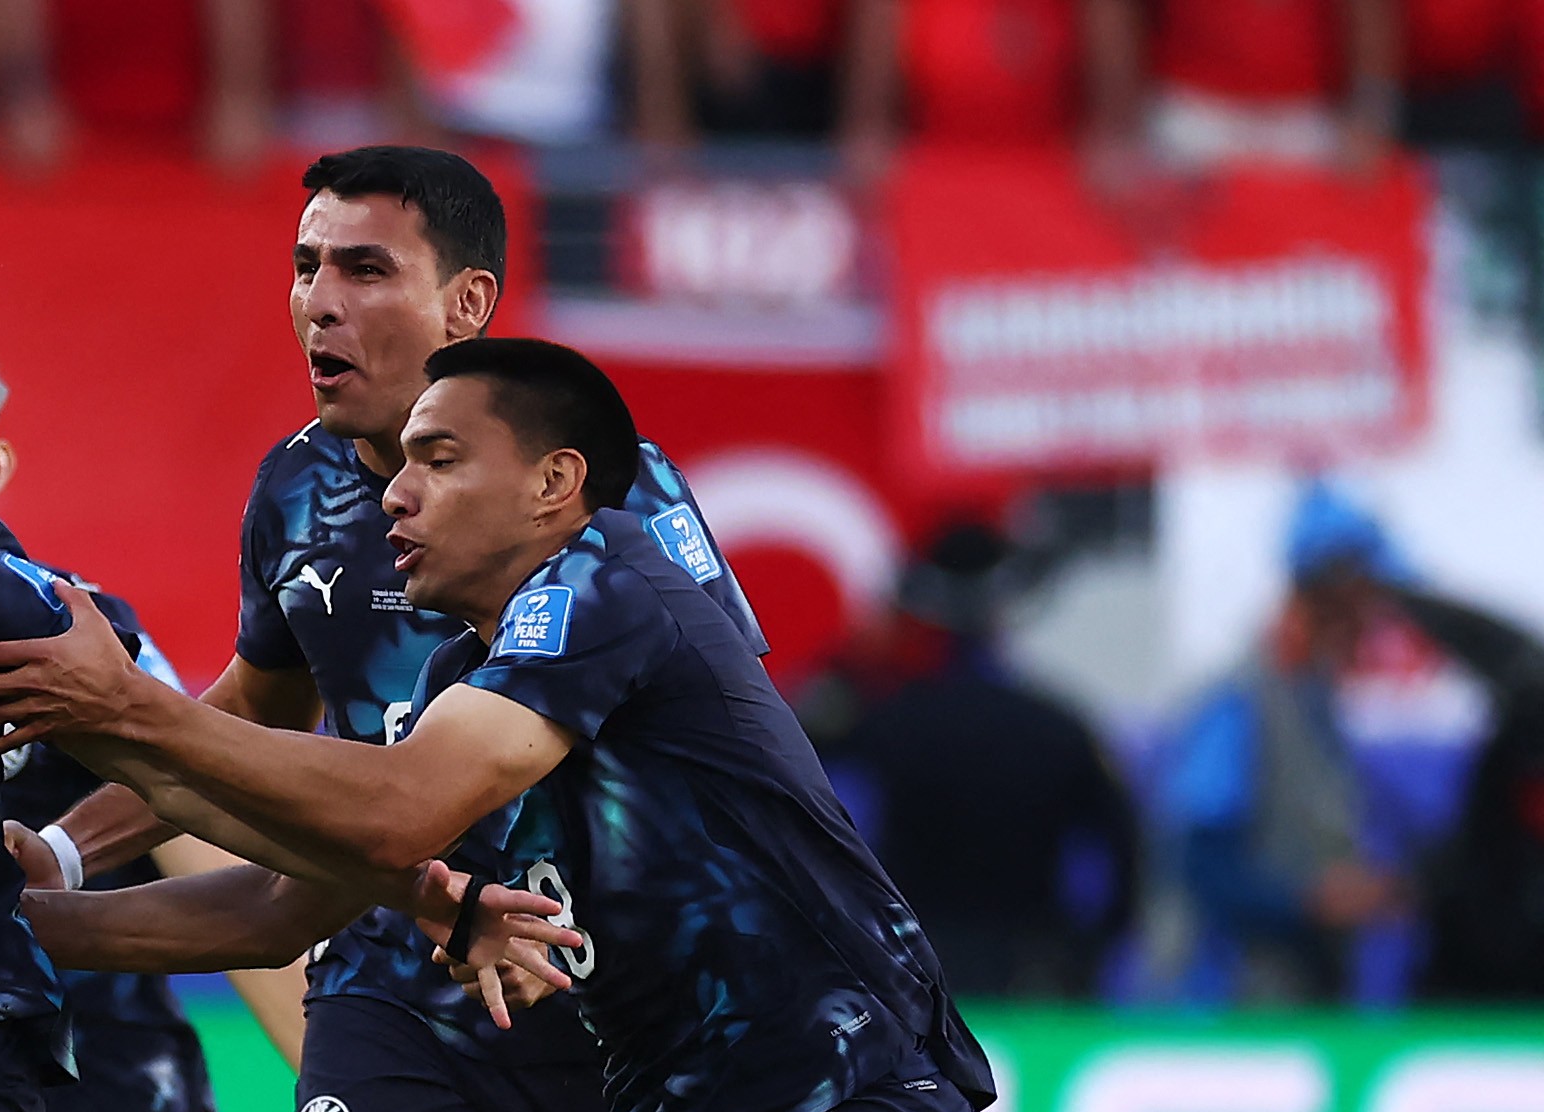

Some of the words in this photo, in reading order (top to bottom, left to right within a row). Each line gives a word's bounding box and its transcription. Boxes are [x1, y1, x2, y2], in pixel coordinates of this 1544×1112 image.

[513, 625, 549, 640] PEACE
[517, 639, 540, 648] FIFA
[527, 857, 595, 980] 8
